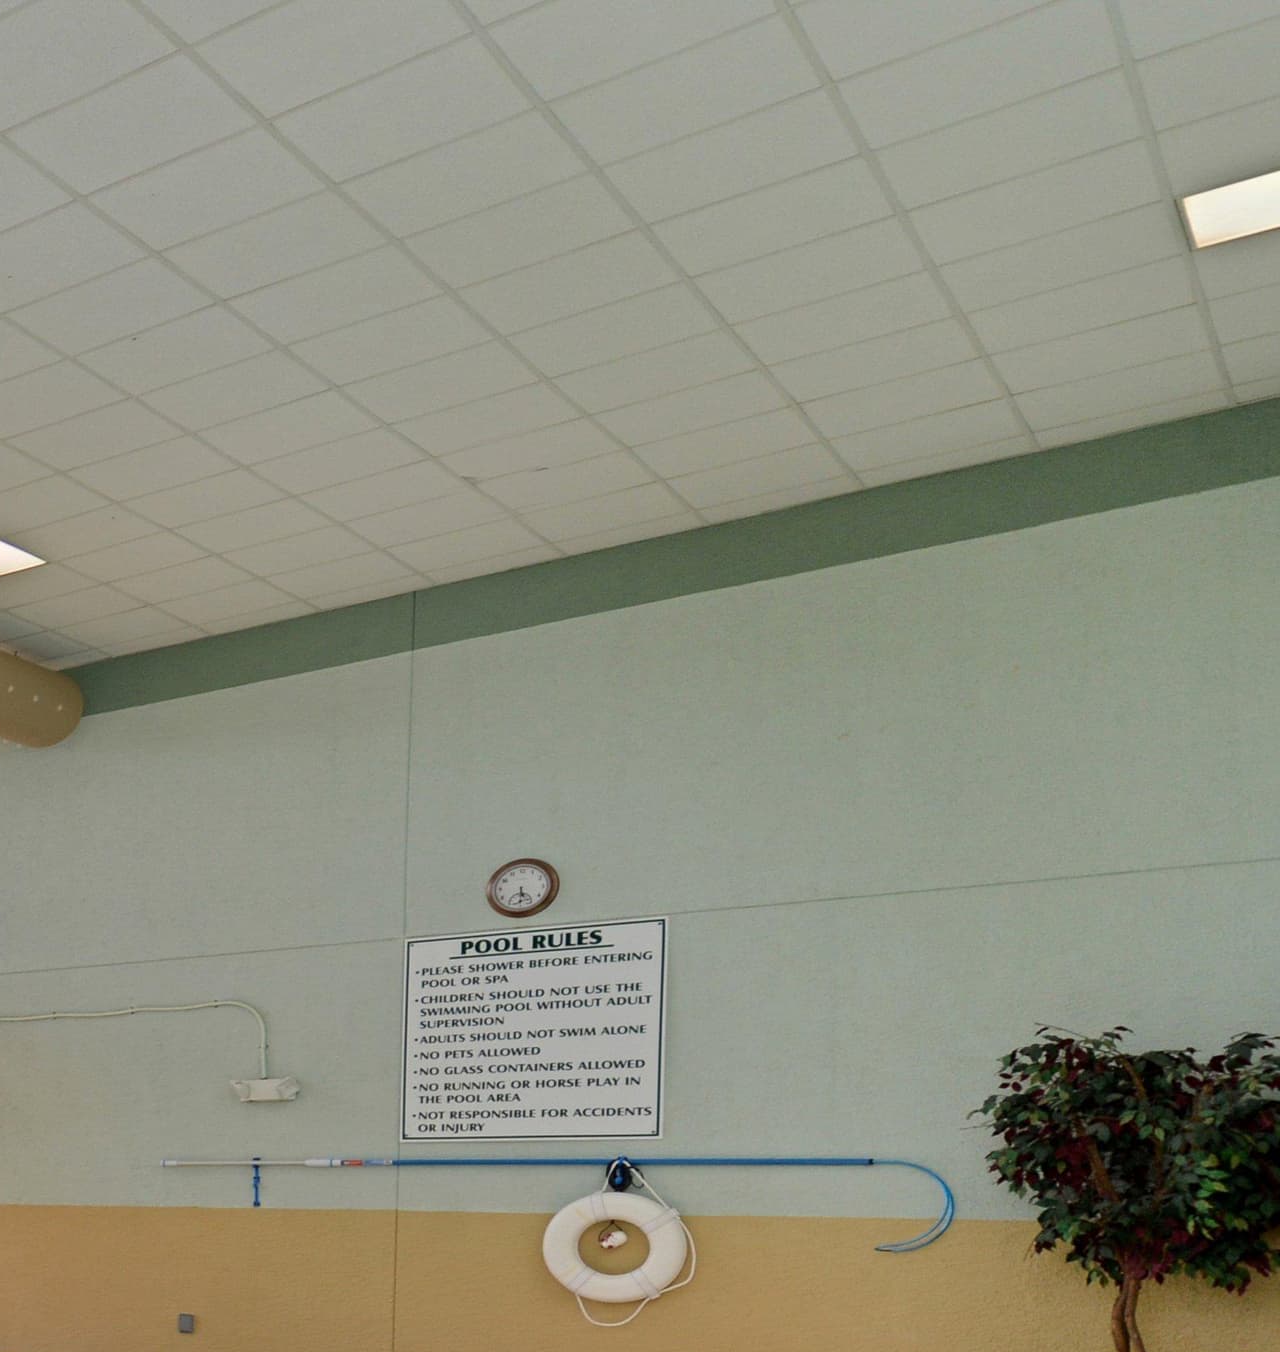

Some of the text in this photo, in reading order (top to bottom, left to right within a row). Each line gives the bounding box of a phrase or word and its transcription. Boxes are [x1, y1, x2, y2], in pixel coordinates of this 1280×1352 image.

[461, 930, 602, 955] POOL RULES
[422, 951, 653, 976] PLEASE SHOWER BEFORE ENTERING
[421, 975, 509, 988] POOL OR SPA
[421, 982, 642, 1004] CHILDREN SHOULD NOT USE THE
[420, 995, 652, 1017] SWIMMING POOL WITHOUT ADULT
[420, 1017, 504, 1029] SUPERVISION
[420, 1025, 646, 1044] ADULTS SHOULD NOT SWIM ALONE
[420, 1046, 541, 1060] NO PETS ALLOWED
[420, 1059, 645, 1076] NO GLASS CONTAINERS ALLOWED
[419, 1077, 641, 1091] NO RUNNING OR HORSE PLAY IN
[419, 1093, 521, 1104] THE POOL AREA
[418, 1107, 652, 1120] NOT RESPONSIBLE FOR ACCIDENTS
[418, 1123, 484, 1134] OR INJURY
